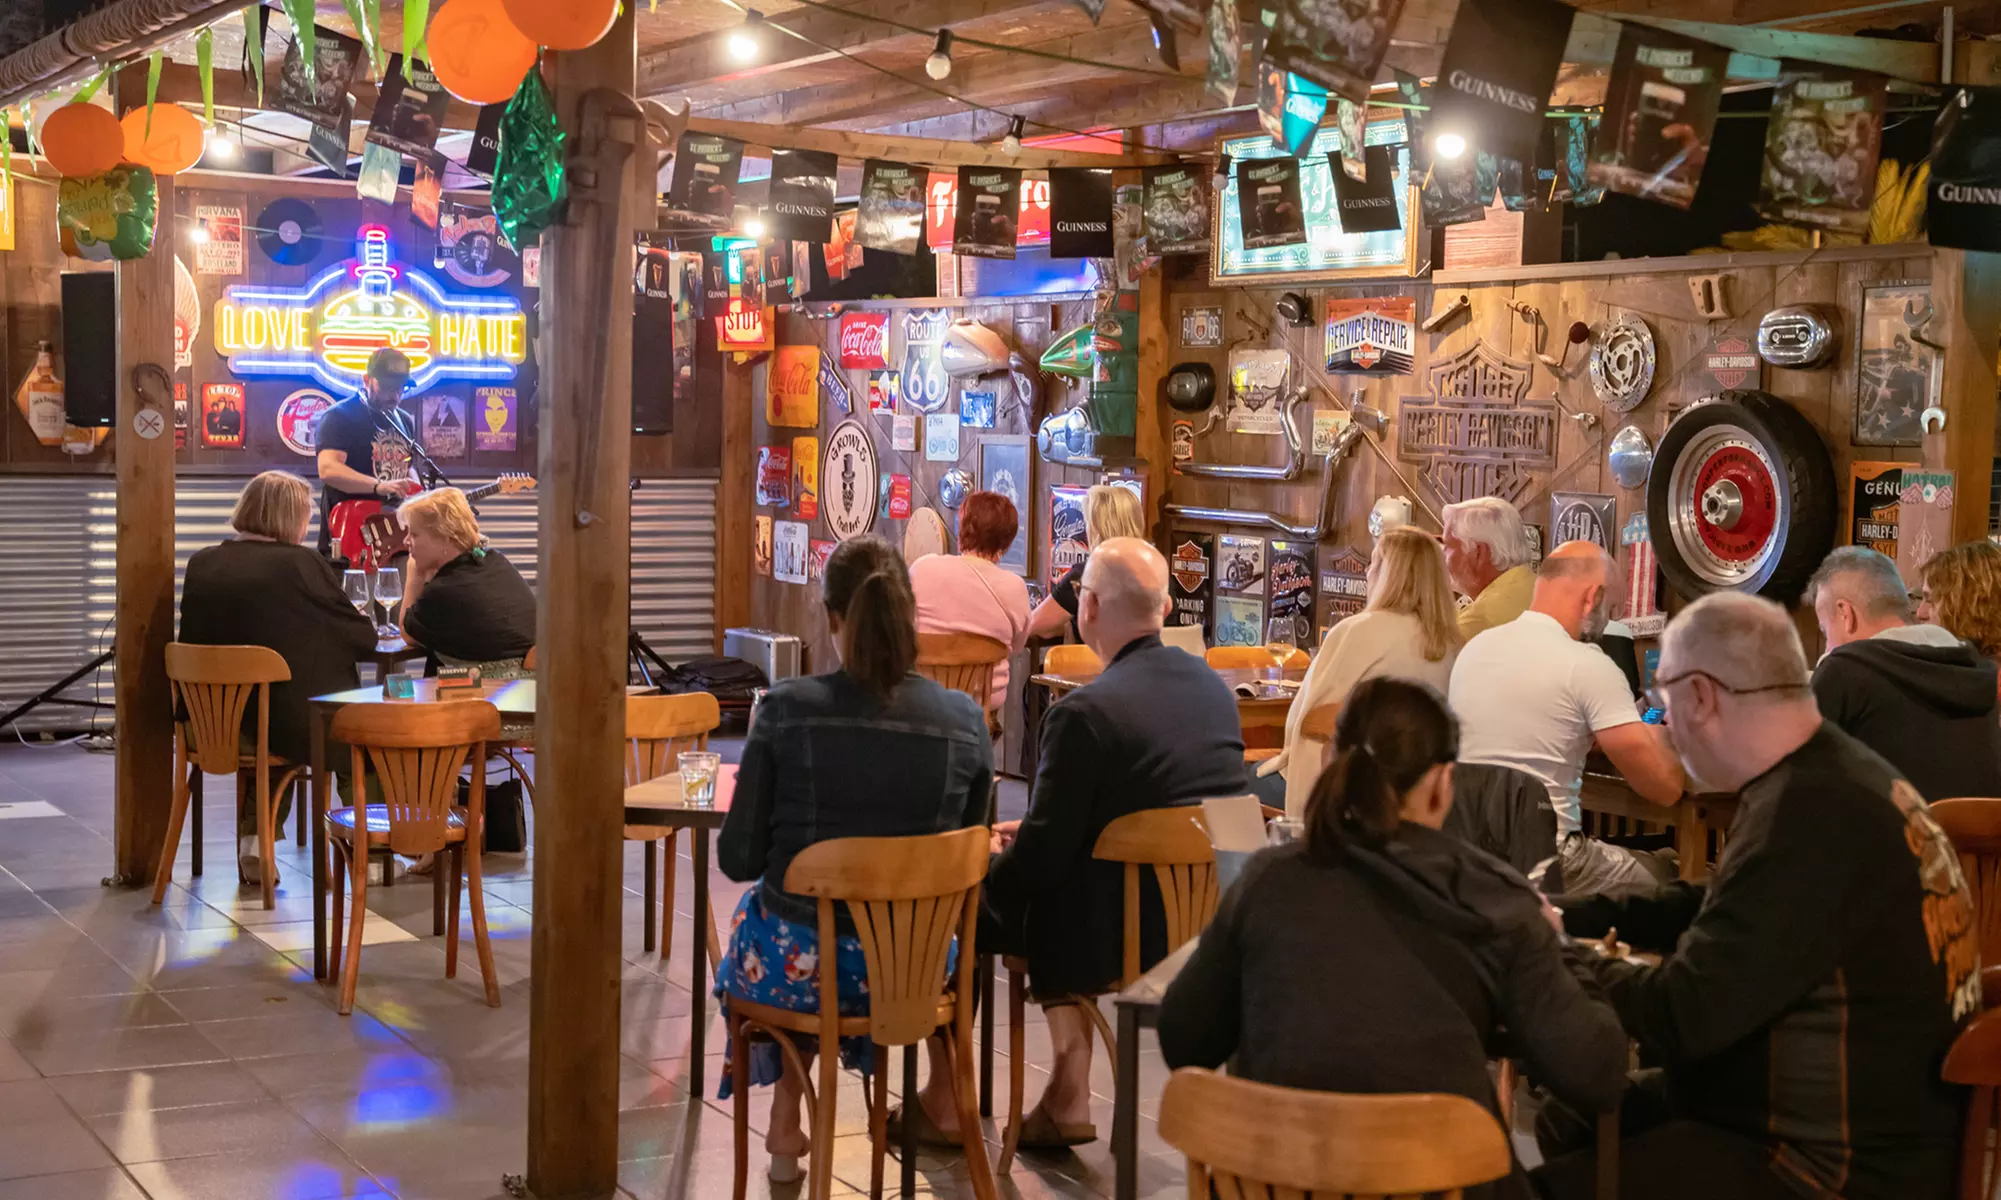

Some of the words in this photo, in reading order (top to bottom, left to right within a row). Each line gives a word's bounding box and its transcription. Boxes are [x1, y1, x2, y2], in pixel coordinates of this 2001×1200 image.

[1449, 69, 1538, 113] GUINNESS
[314, 124, 347, 151] GUINNESS
[197, 206, 239, 217] NIRVANA
[775, 202, 828, 217] GUINNESS
[1343, 197, 1391, 209] GUINNESS
[1056, 220, 1108, 232] GUINNESS
[646, 289, 668, 299] GUINNESS
[707, 290, 728, 299] GUINNESS
[222, 304, 313, 351] LOVE
[727, 311, 760, 331] STOP
[852, 321, 867, 329] DRINK
[1209, 315, 1219, 339] 66
[439, 312, 523, 358] HATE
[1327, 316, 1366, 350] SERVICE
[1371, 316, 1407, 351] REPAIR
[919, 347, 930, 358] US
[1707, 355, 1756, 368] HARLEY-DAVIDSON
[908, 358, 940, 401] 66
[1440, 364, 1515, 398] MOTOR
[475, 387, 517, 397] PRINCE
[826, 375, 847, 406] BEER
[287, 397, 329, 421] Fender
[1406, 411, 1464, 446] HARLEY
[1468, 412, 1548, 450] DAVIDSON
[830, 433, 868, 463] GROWLS
[1173, 444, 1190, 457] GARAGE
[1334, 559, 1363, 574] MOTOR
[1322, 575, 1368, 597] HARLEY-DAVIDS
[1179, 613, 1199, 625] ONLY
[439, 667, 469, 675] RESERVED
